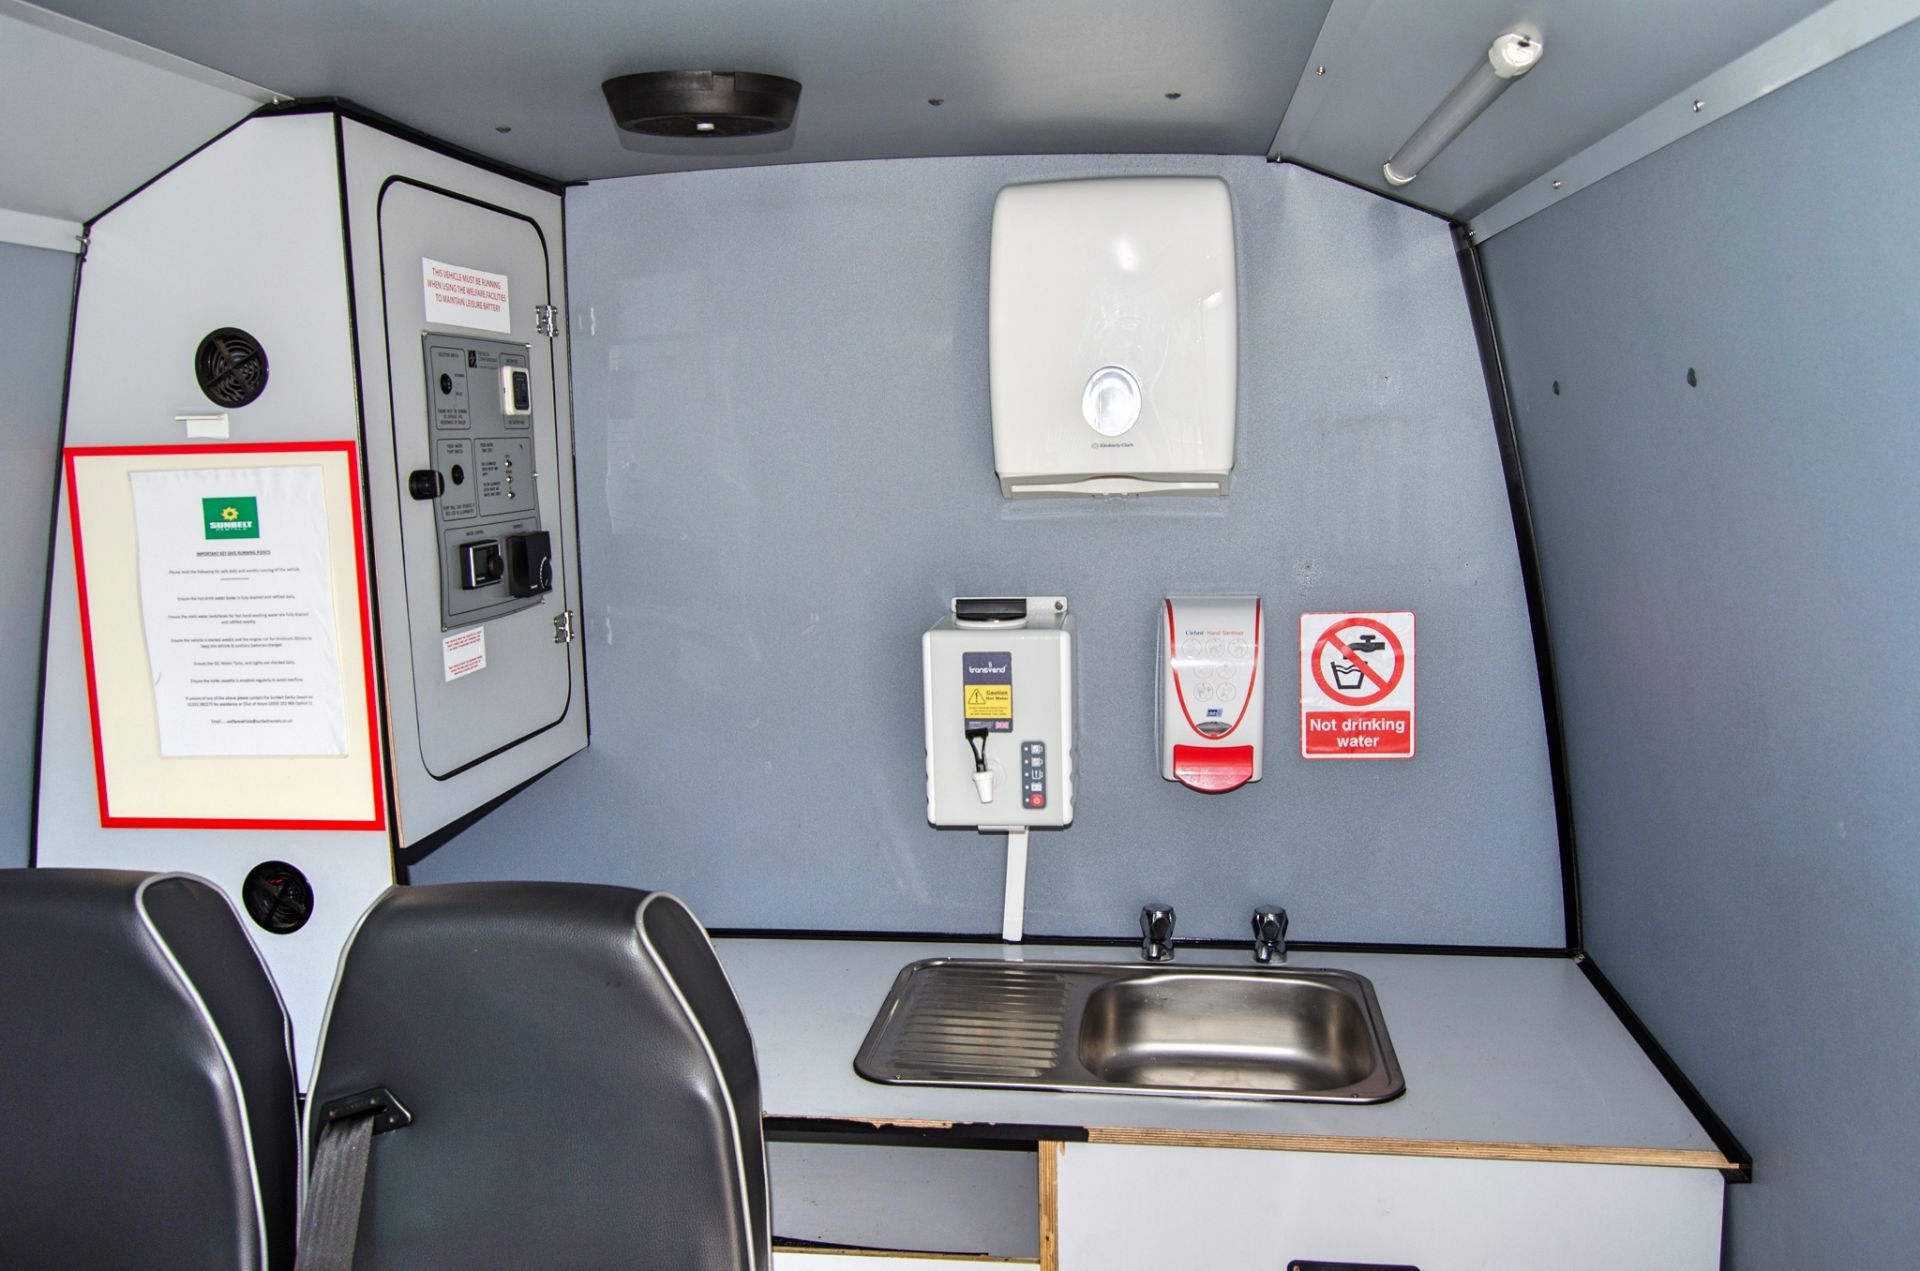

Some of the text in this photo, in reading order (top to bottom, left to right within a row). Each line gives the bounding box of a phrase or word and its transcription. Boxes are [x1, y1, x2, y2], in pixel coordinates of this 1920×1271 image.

[444, 270, 461, 281] VEHICLE
[210, 521, 253, 529] SUNBELT
[968, 662, 1006, 674] transvend
[1310, 717, 1405, 734] Not drinking
[1336, 735, 1380, 748] water
